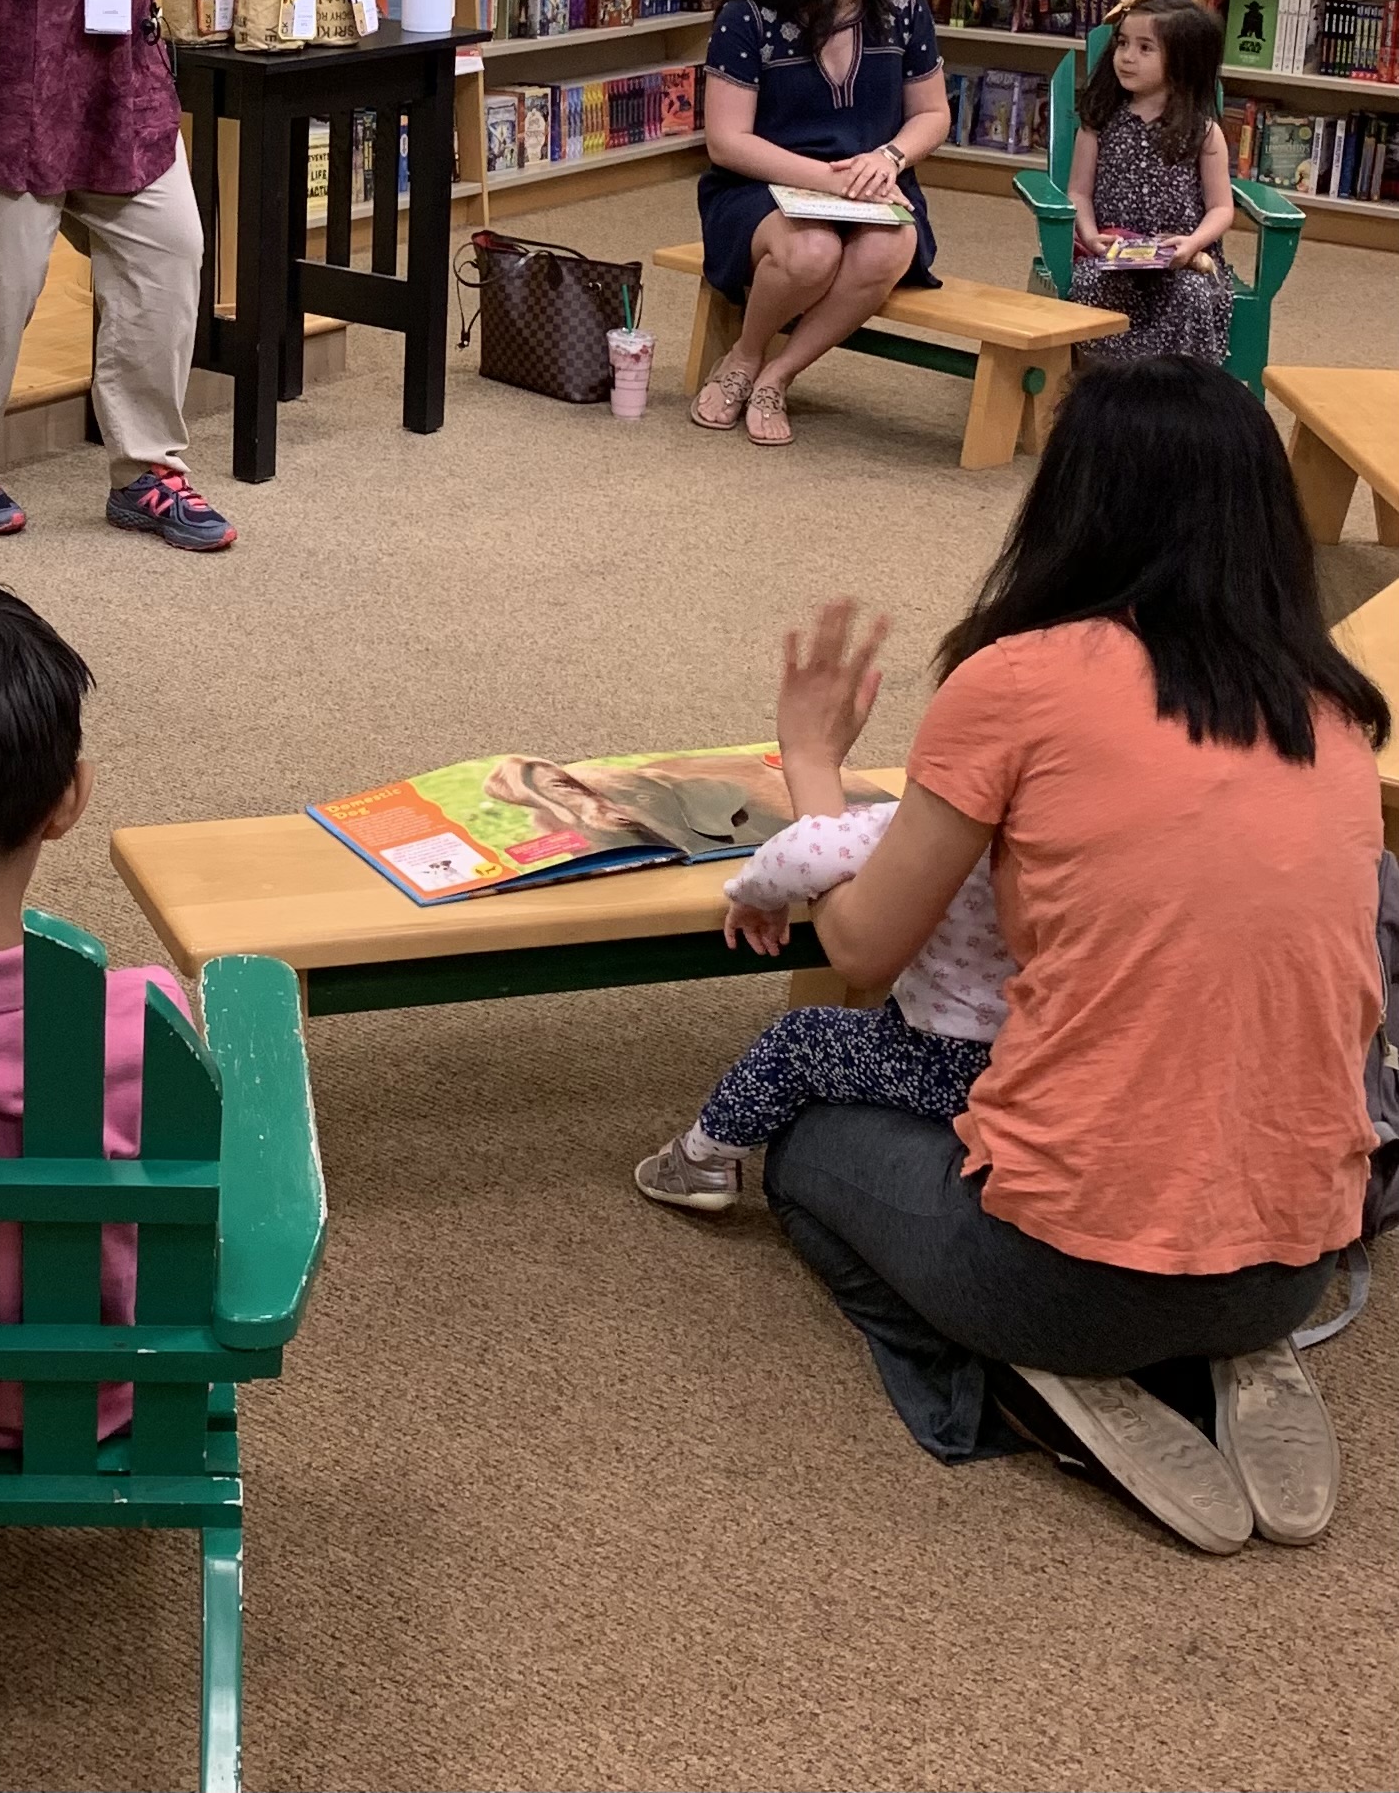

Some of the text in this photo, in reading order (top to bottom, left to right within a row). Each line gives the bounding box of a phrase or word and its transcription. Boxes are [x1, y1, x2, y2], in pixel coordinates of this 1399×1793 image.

[310, 169, 327, 182] LIFE
[324, 788, 402, 814] Domestic
[332, 806, 371, 820] Dog
